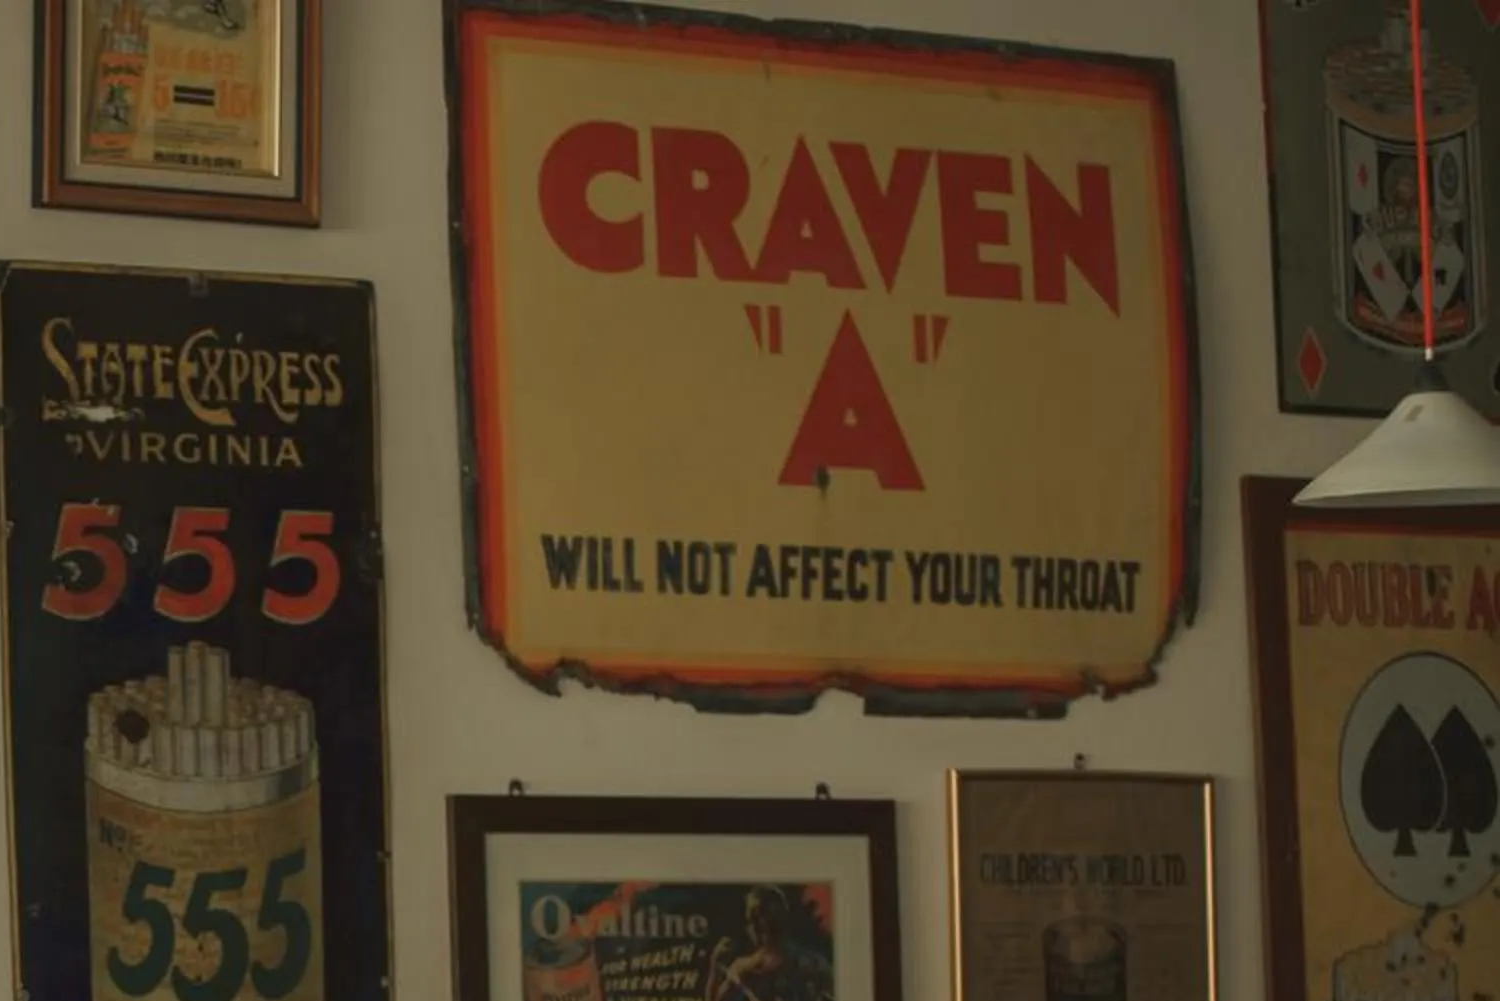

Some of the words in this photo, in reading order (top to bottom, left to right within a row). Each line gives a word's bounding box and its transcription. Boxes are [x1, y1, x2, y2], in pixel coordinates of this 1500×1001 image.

[537, 119, 1121, 319] CRAVEN
[177, 329, 344, 425] EXPRESS
[86, 431, 303, 467] VIRGINIA
[540, 534, 644, 593] WILL
[656, 539, 737, 597] NOT
[745, 543, 894, 602] AFFECT
[903, 551, 1004, 608] YOUR
[1011, 556, 1140, 613] THROAT
[1296, 559, 1456, 631] DOUBLE
[530, 894, 709, 940] Ovaltine
